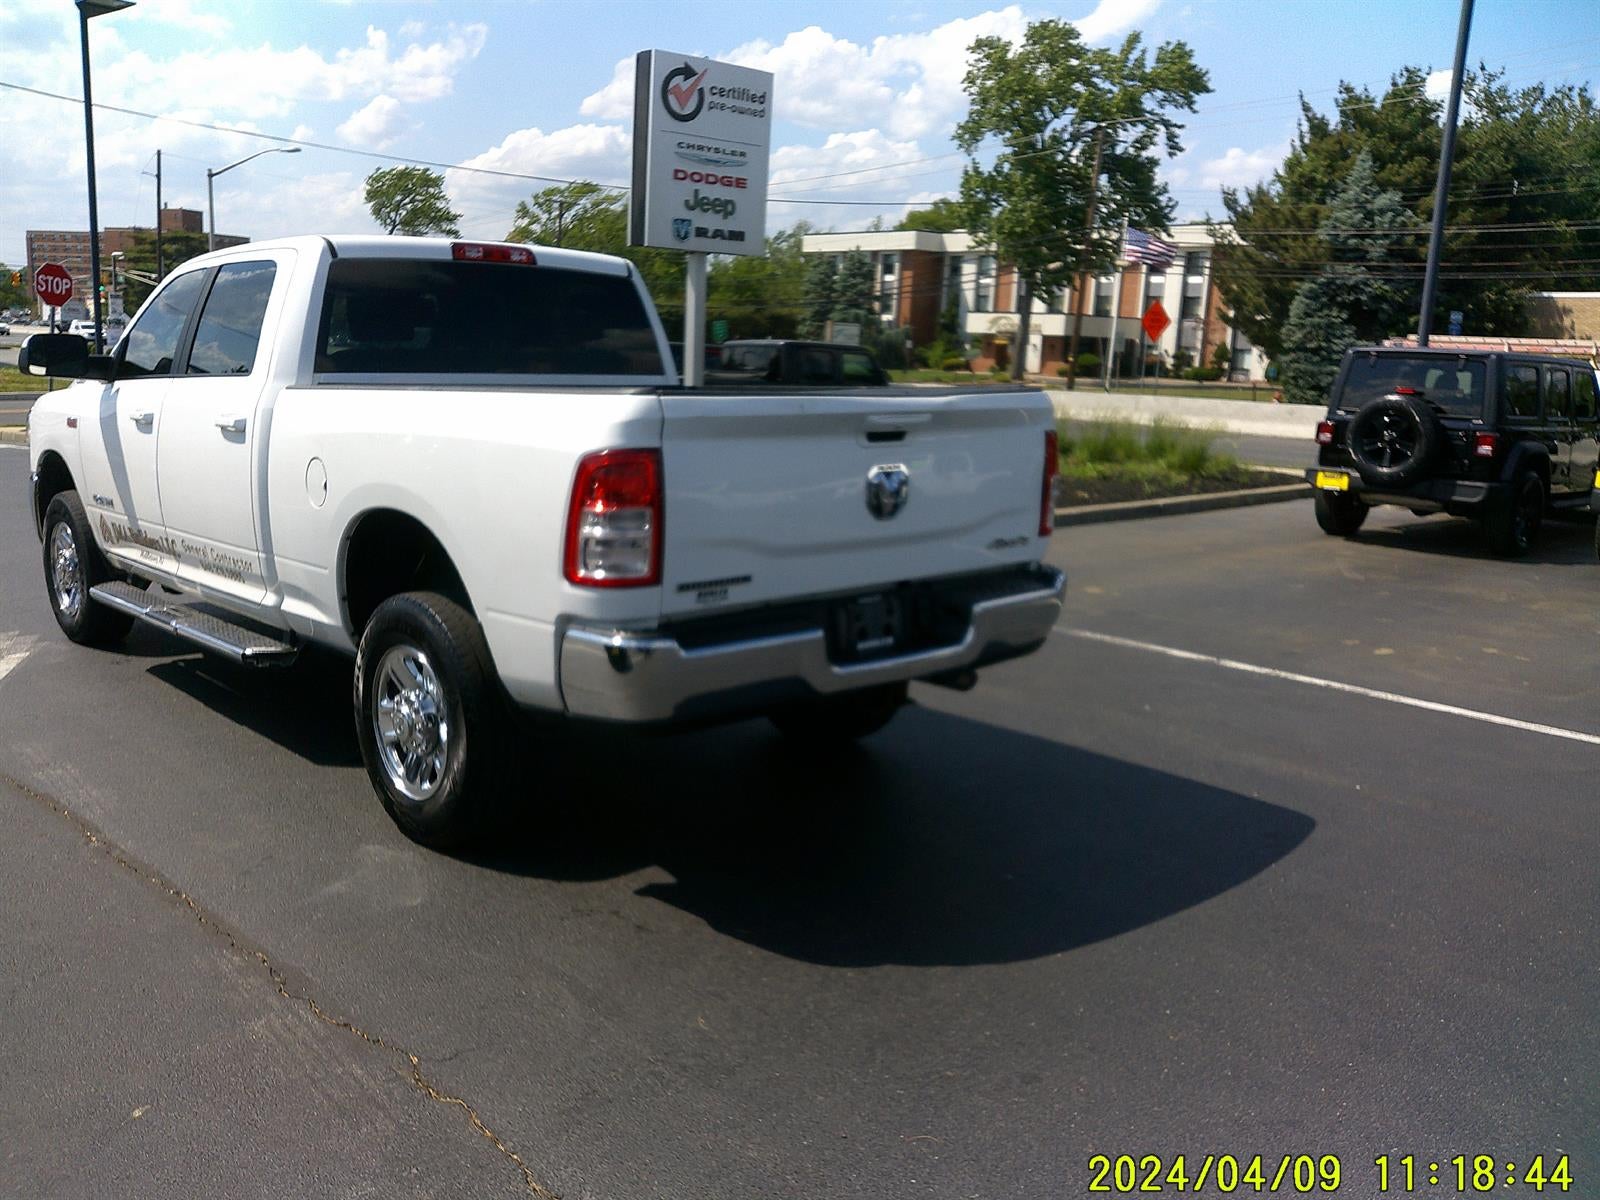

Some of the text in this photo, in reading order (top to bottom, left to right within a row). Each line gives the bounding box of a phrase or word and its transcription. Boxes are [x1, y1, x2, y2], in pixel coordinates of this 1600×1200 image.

[709, 86, 767, 105] certified
[708, 100, 766, 118] pre-owned
[676, 141, 748, 158] CHRYSLER
[672, 168, 748, 189] DODGE
[684, 188, 737, 220] Jeep
[694, 226, 746, 242] RAM
[37, 274, 72, 295] STOP
